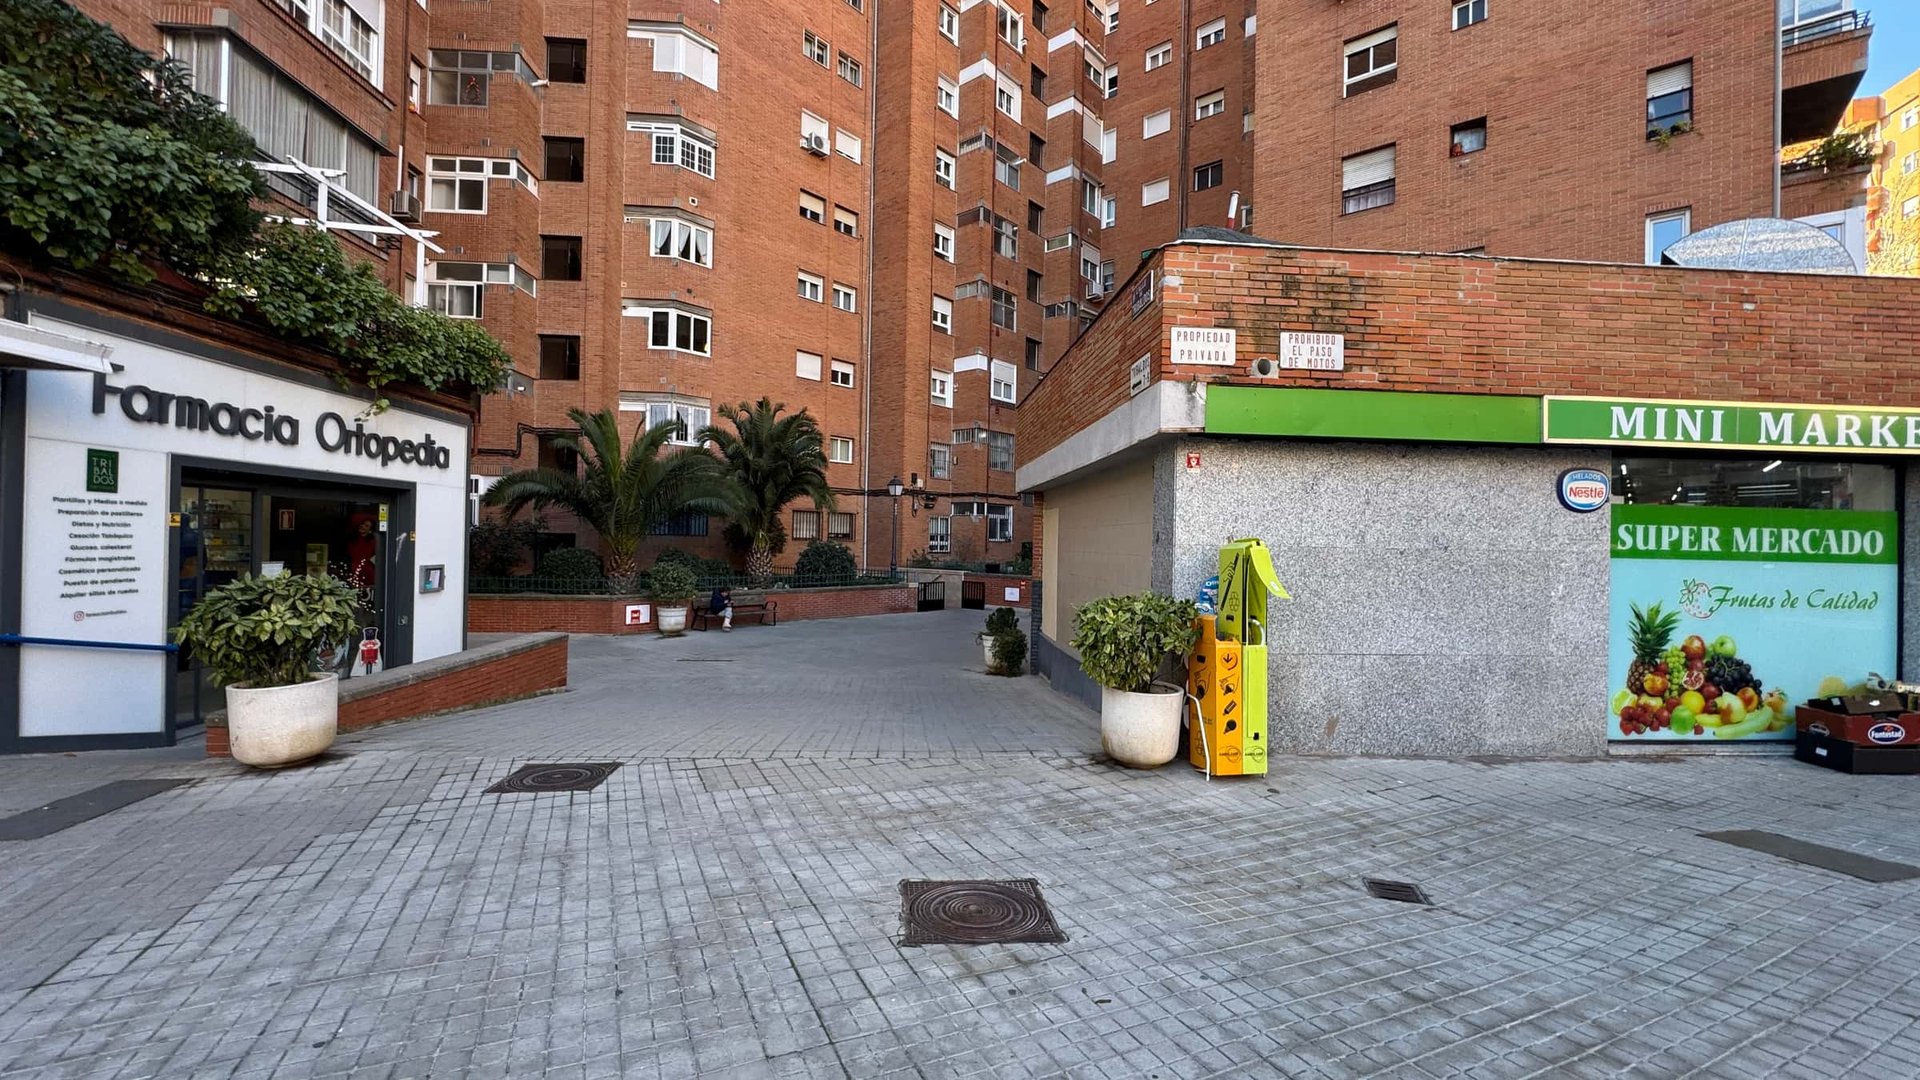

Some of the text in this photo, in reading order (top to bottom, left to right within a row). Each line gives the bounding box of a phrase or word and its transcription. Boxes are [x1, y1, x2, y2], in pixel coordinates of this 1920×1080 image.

[1176, 331, 1231, 344] PROPIEDAD
[1288, 333, 1336, 346] PROHIBIDO
[1180, 349, 1227, 362] PRIVADA
[1292, 345, 1332, 357] EL PASO
[1288, 356, 1336, 369] DE MOTOS
[92, 362, 450, 468] Farmacia Ortopedia
[1610, 406, 1920, 448] MINI MARKE
[92, 457, 112, 468] TRI
[93, 466, 112, 476] BAL
[1572, 472, 1601, 481] HELADOS
[93, 475, 115, 485] DOS
[1617, 523, 1885, 556] SUPER MERCADO
[1708, 585, 1879, 615] Frutas de Calidad
